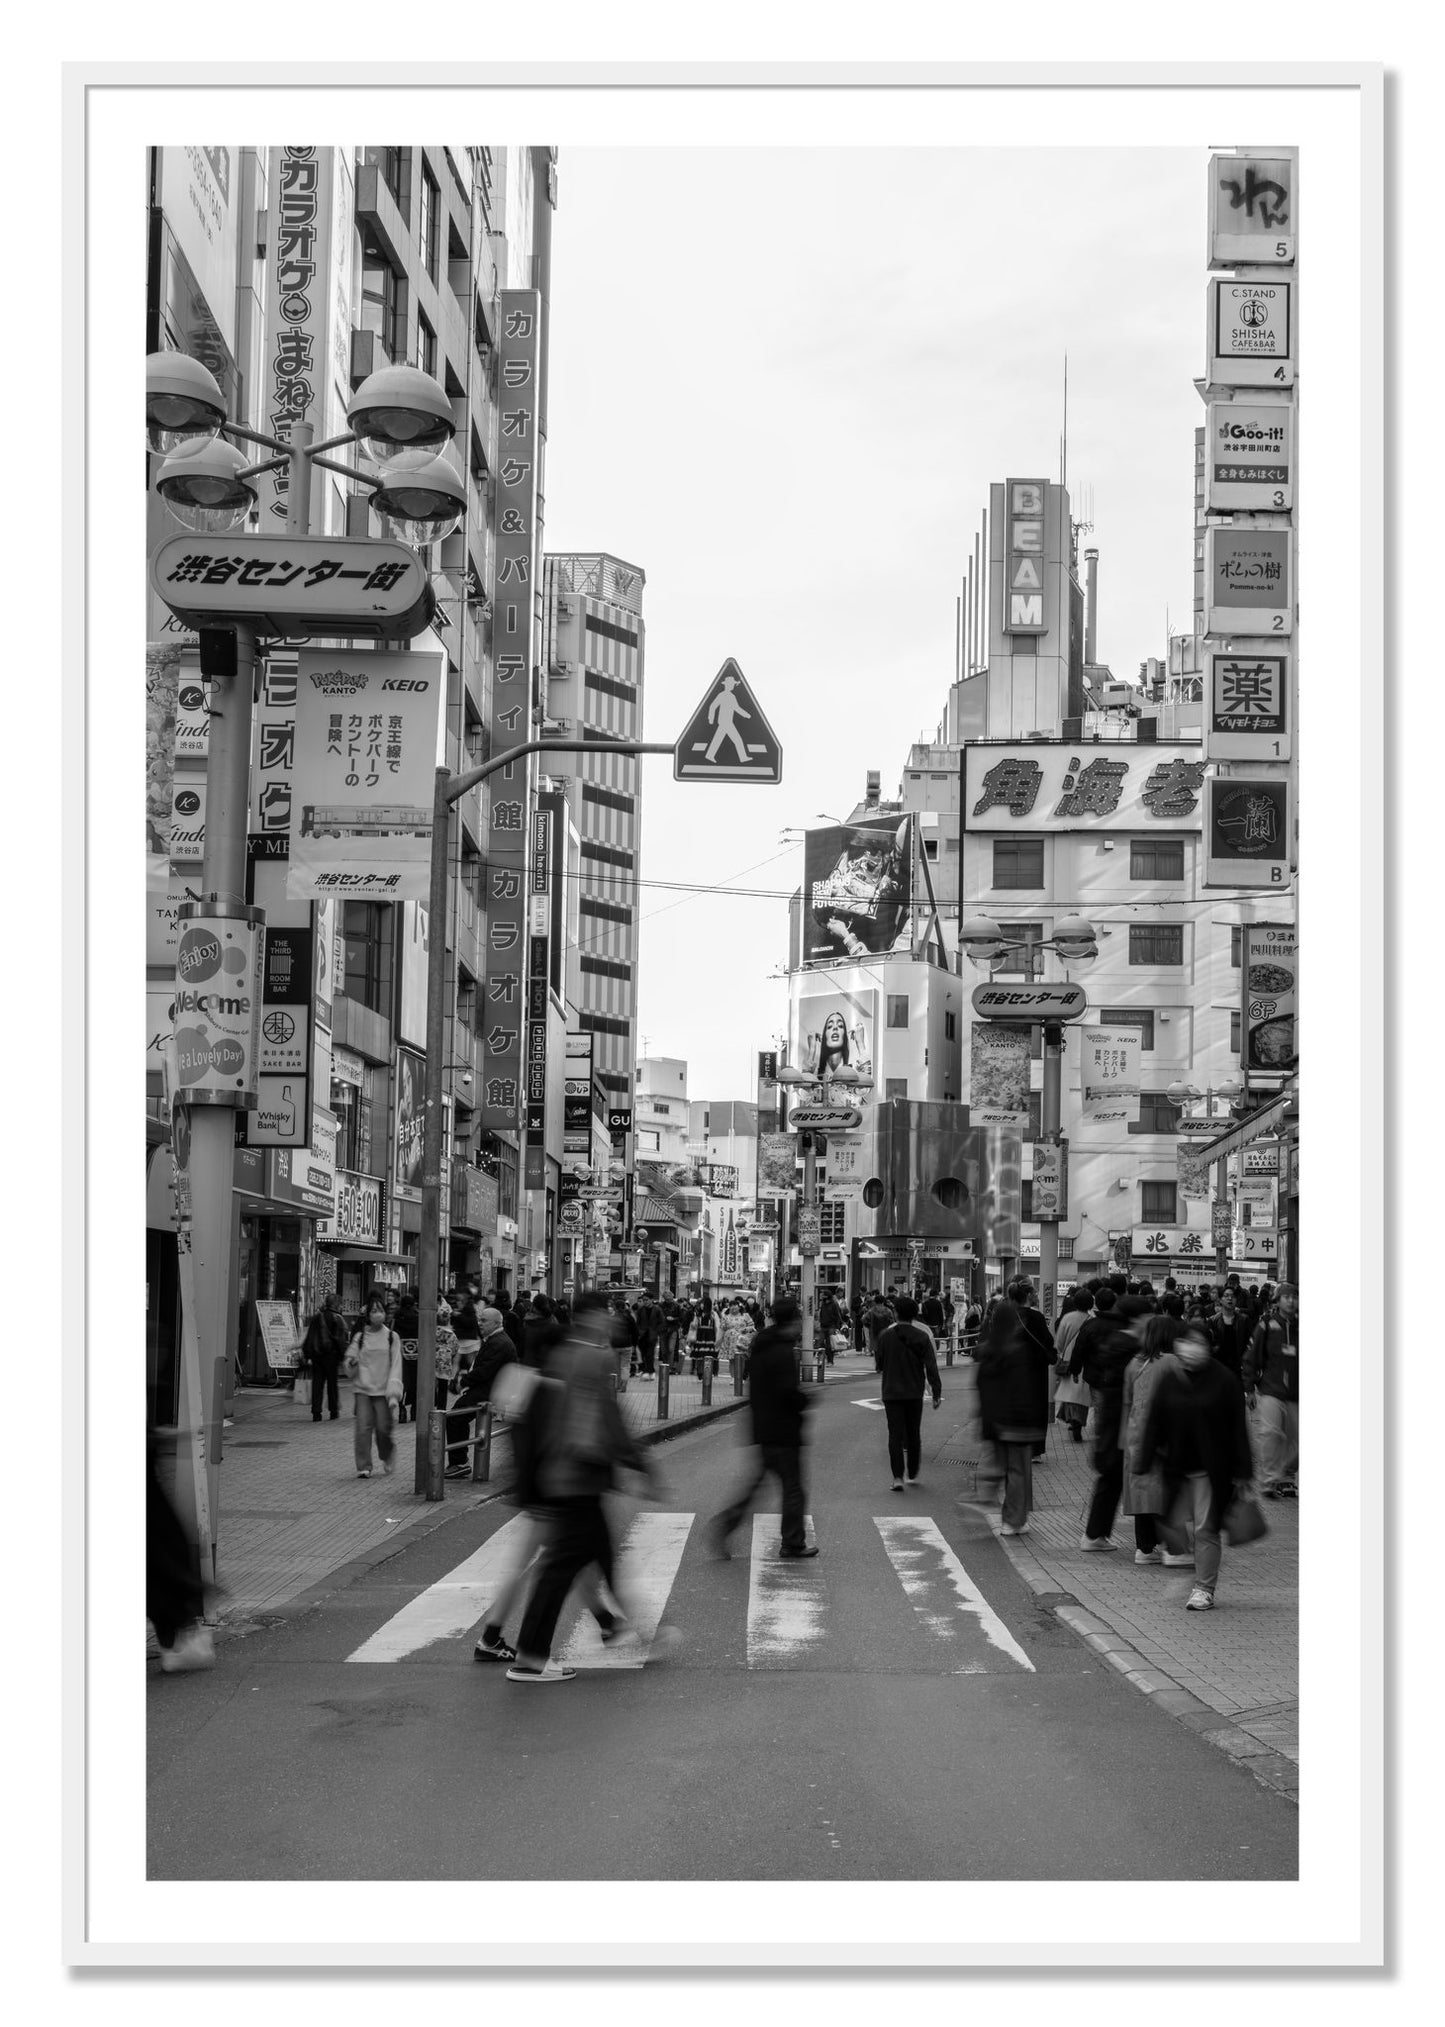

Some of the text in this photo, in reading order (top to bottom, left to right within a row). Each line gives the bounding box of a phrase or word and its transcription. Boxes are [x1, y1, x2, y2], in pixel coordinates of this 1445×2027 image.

[277, 159, 318, 295] カラオケ
[1275, 242, 1287, 258] 5
[1231, 288, 1276, 299] C.STAND
[1231, 329, 1276, 340] SHISHA
[1274, 366, 1286, 381] 4
[1230, 424, 1284, 440] Goo-it!
[1218, 468, 1285, 480] 全身もみほぐし
[1273, 490, 1285, 507] 3
[1010, 484, 1044, 626] BEAM
[166, 554, 412, 592] 渋谷センター街
[1272, 615, 1284, 631] 2
[322, 687, 357, 695] KANTO
[381, 679, 430, 693] KEIO
[1222, 662, 1273, 713] 薬
[1216, 715, 1278, 730] マツモトキヨシ
[327, 713, 343, 756] 冒険へ
[345, 713, 363, 787] カントーの
[386, 715, 403, 774] 京王線で
[1271, 741, 1280, 756] 1
[536, 815, 546, 889] kimono hearts
[314, 873, 402, 887] 渋谷センター街
[1271, 866, 1283, 882] B
[178, 940, 219, 977] Enjoy
[1250, 944, 1295, 957] 四川料理
[486, 870, 521, 1108] カラオケ館
[175, 990, 251, 1015] Welcome
[979, 991, 1080, 1005] 渋谷センター街
[1249, 1000, 1277, 1020] 6F
[192, 1046, 222, 1066] Lovely
[223, 1048, 243, 1062] Day!
[576, 1086, 589, 1094] UP
[257, 1111, 291, 1123] Whisky
[610, 1114, 630, 1127] GU
[792, 1111, 853, 1122] 渋谷センター街
[257, 1120, 277, 1130] Bank
[1145, 1231, 1204, 1253] 兆楽
[726, 1230, 736, 1272] BEER
